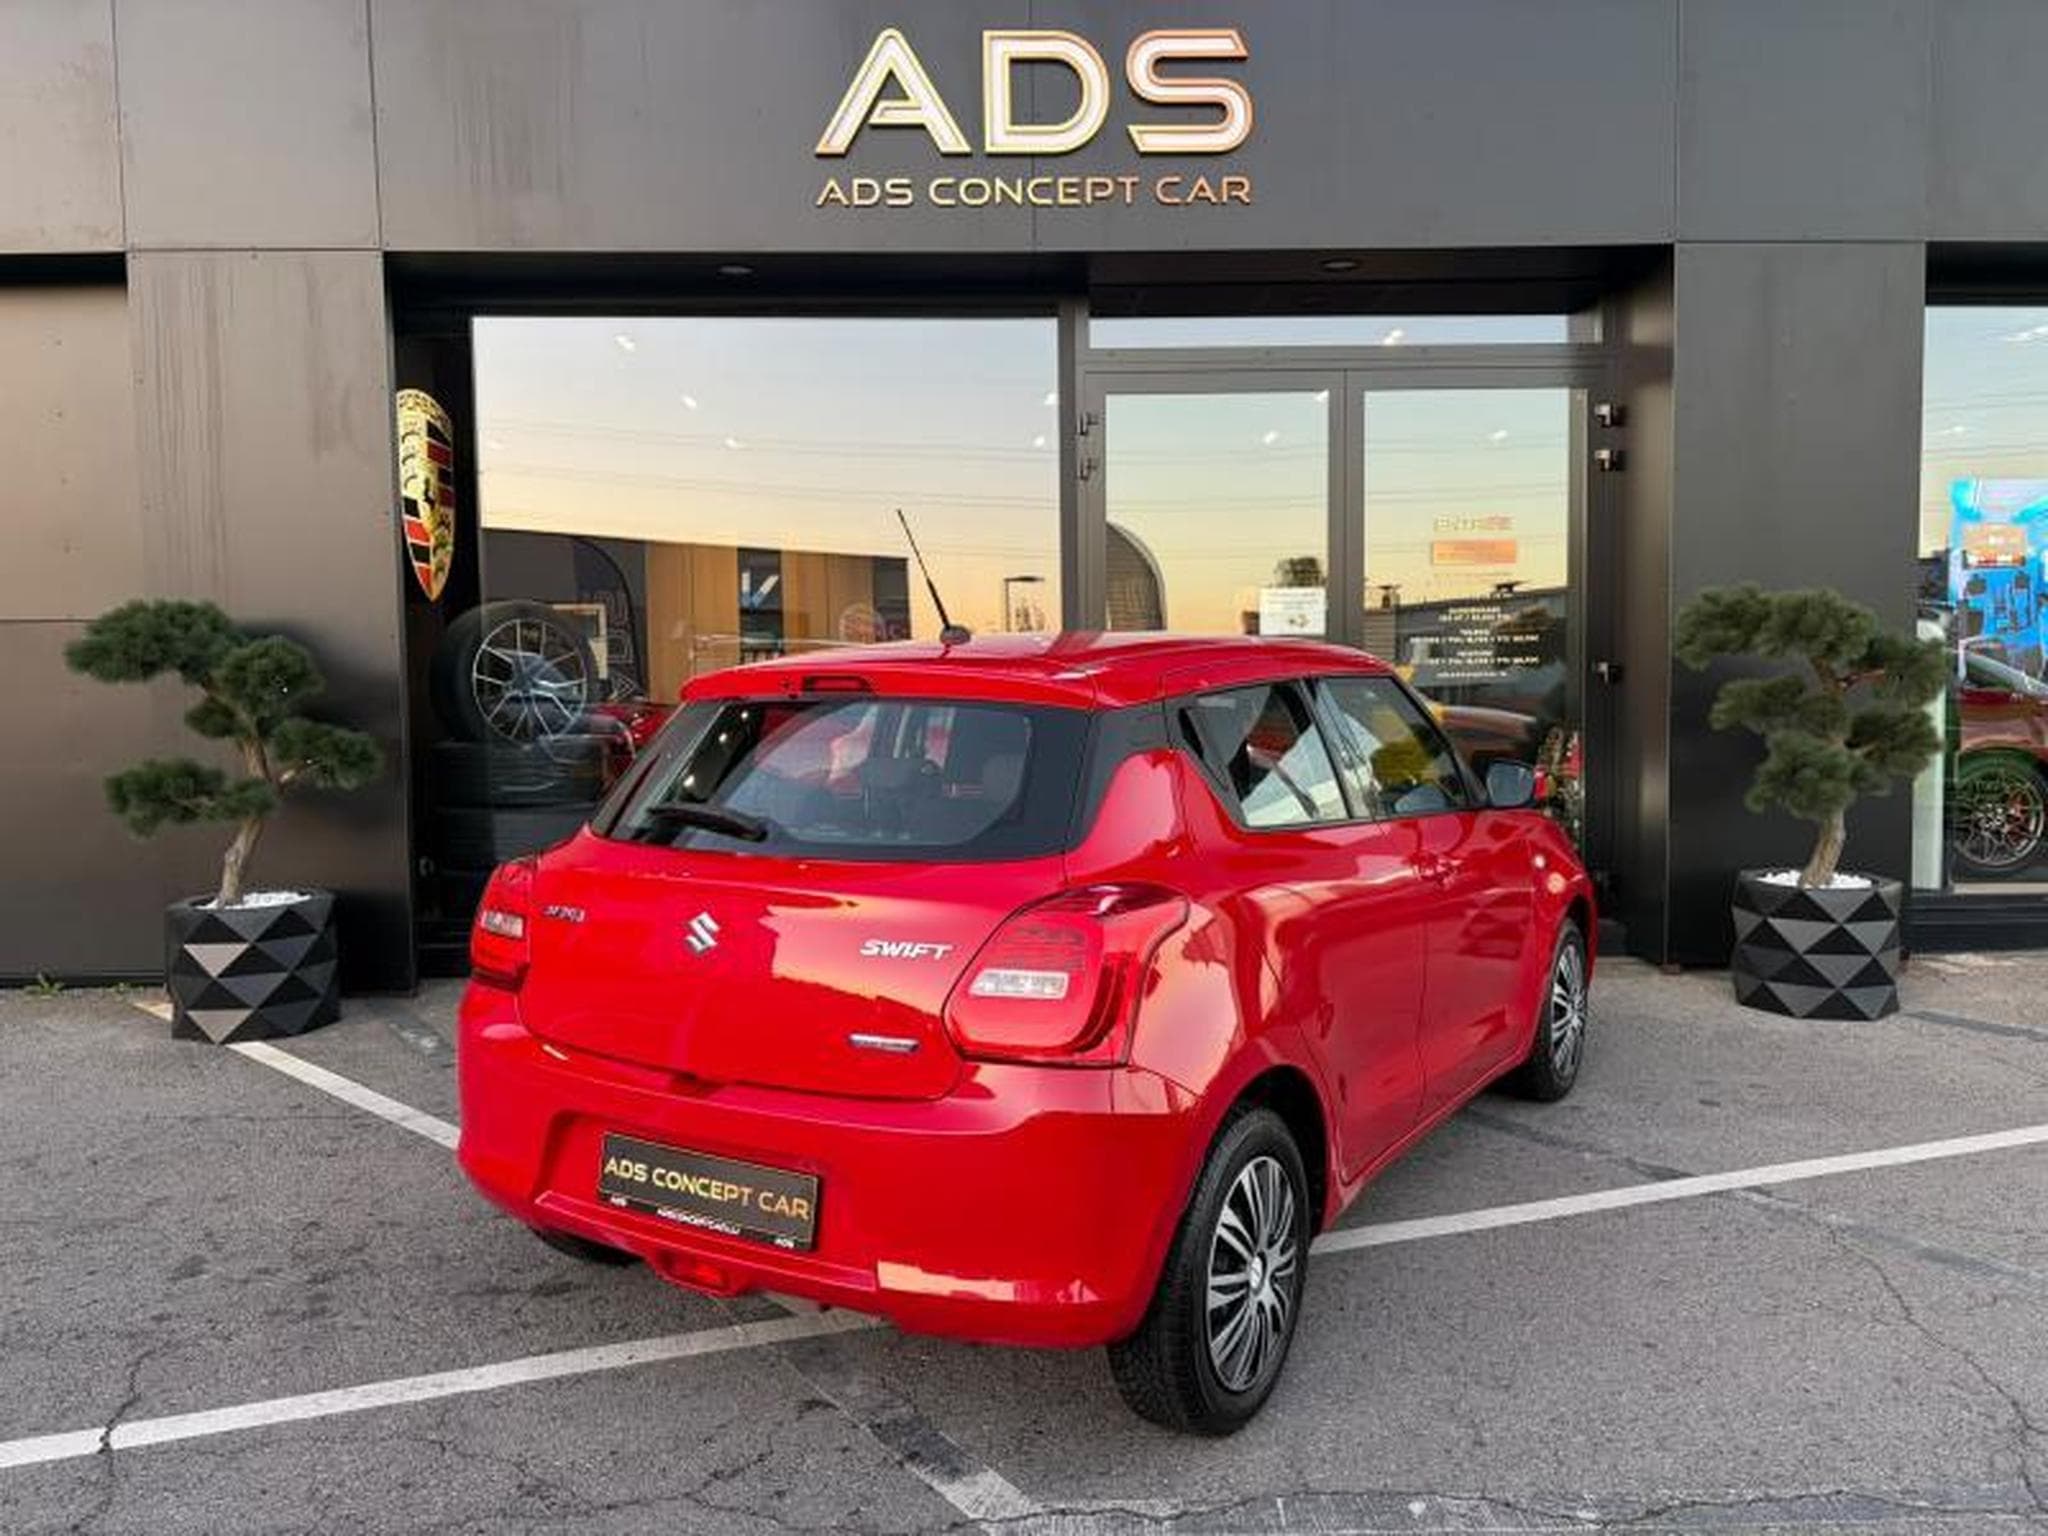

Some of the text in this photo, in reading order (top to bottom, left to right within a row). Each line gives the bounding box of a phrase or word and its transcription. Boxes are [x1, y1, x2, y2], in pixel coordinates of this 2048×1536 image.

[814, 27, 1254, 156] ADS
[816, 175, 1252, 207] ADS CONCEPT CAR
[860, 939, 953, 960] SWIFT
[604, 1157, 810, 1220] ADS CONCEPT CAR
